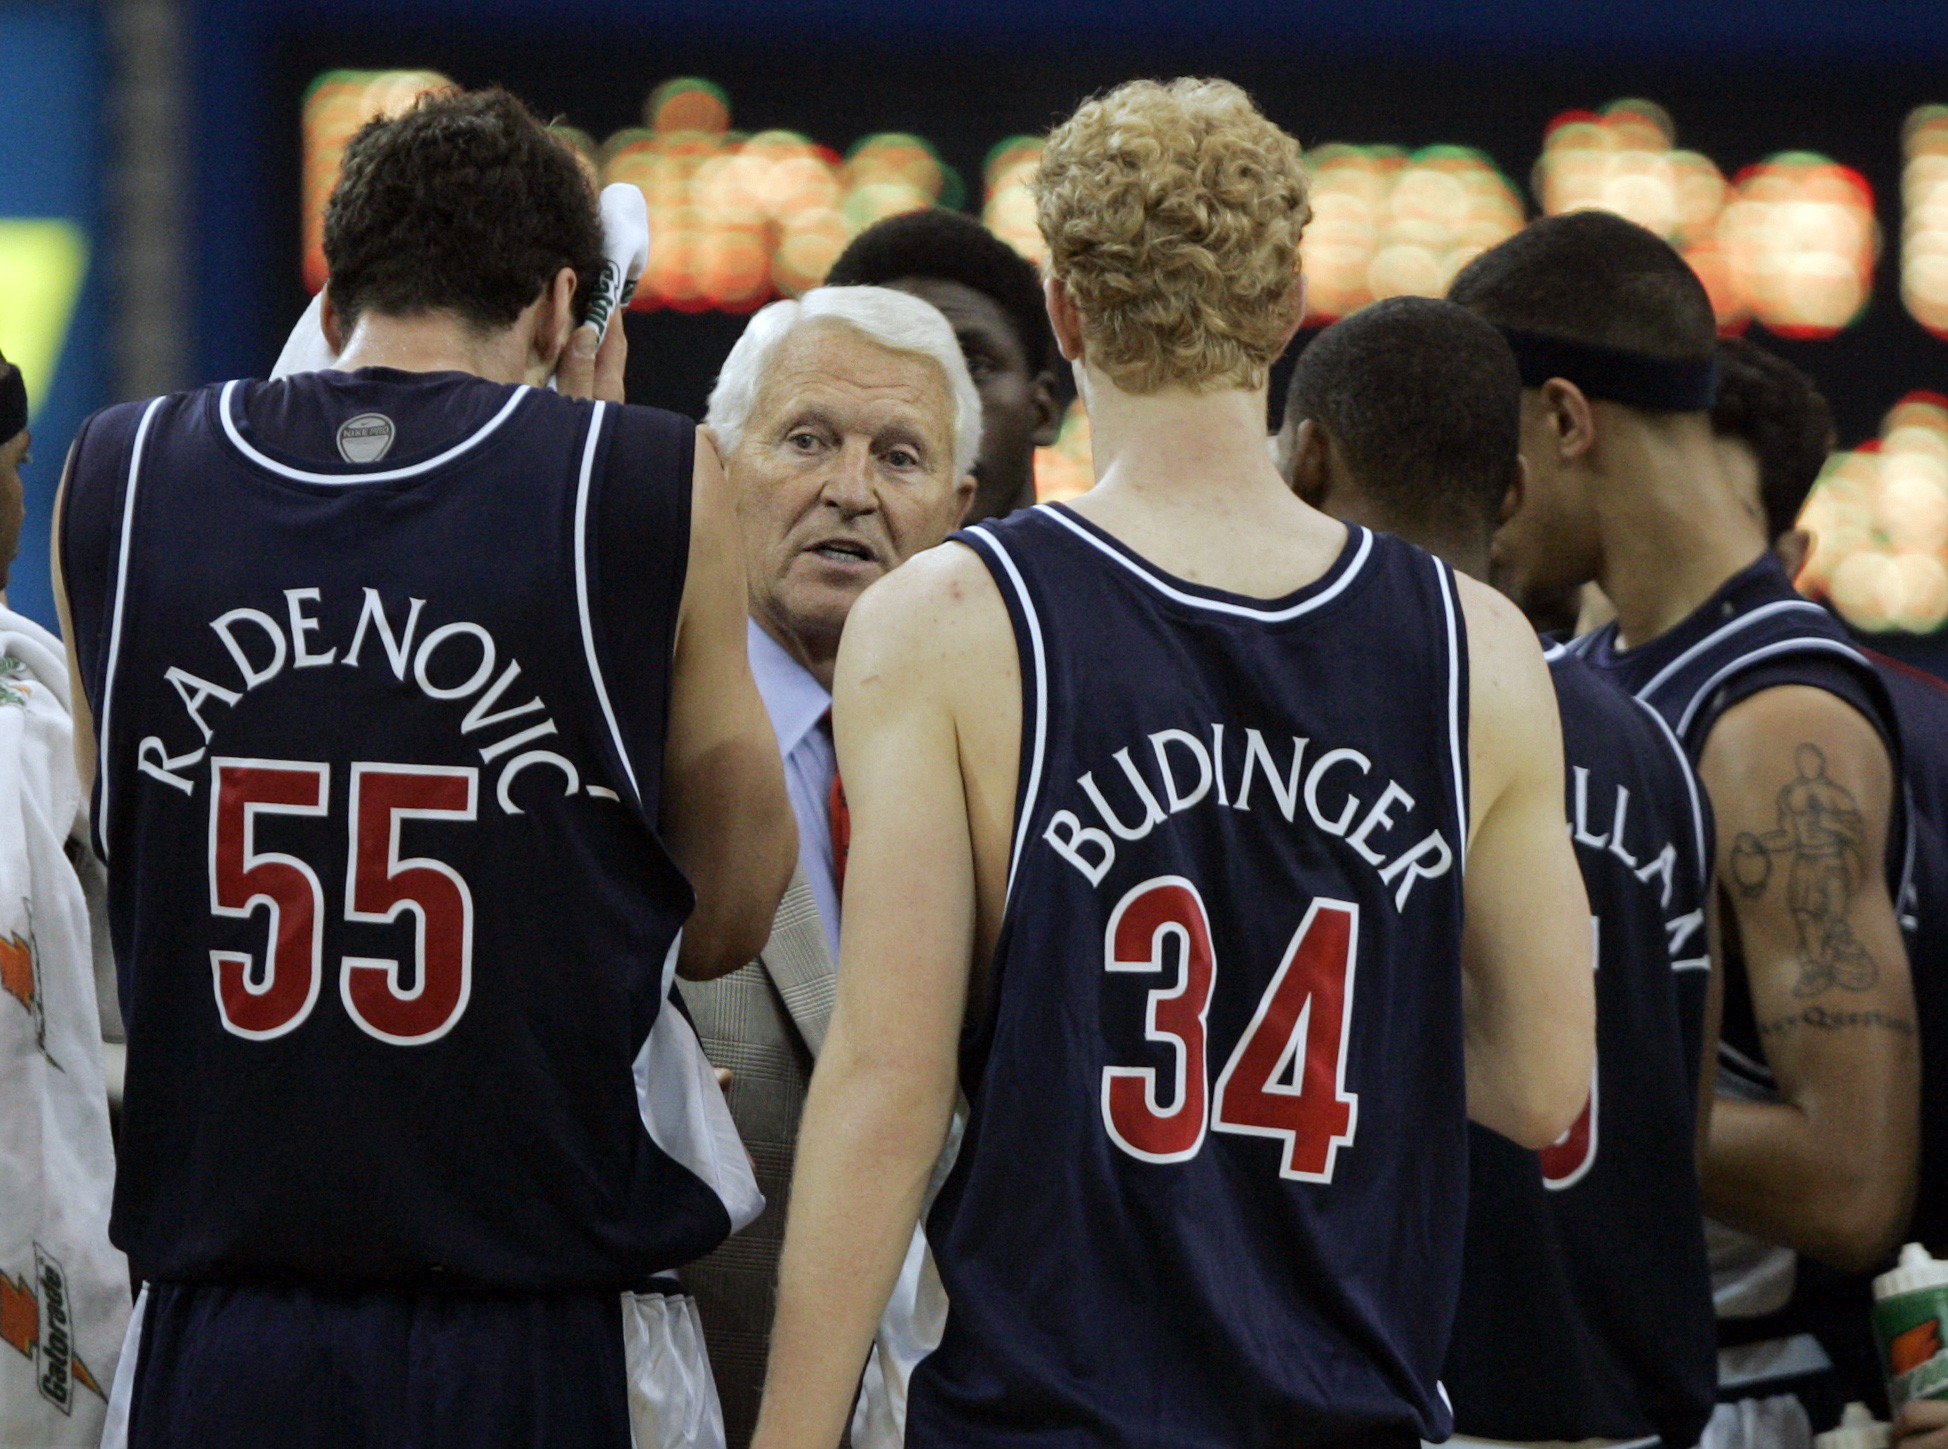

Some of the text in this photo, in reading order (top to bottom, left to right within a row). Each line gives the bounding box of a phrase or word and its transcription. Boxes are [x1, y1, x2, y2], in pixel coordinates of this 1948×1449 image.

[343, 428, 368, 437] NIKE
[208, 756, 479, 1047] 55
[1042, 723, 1453, 913] BUDINGER
[1101, 875, 1359, 1184] 34
[42, 1264, 69, 1404] Gatorade
